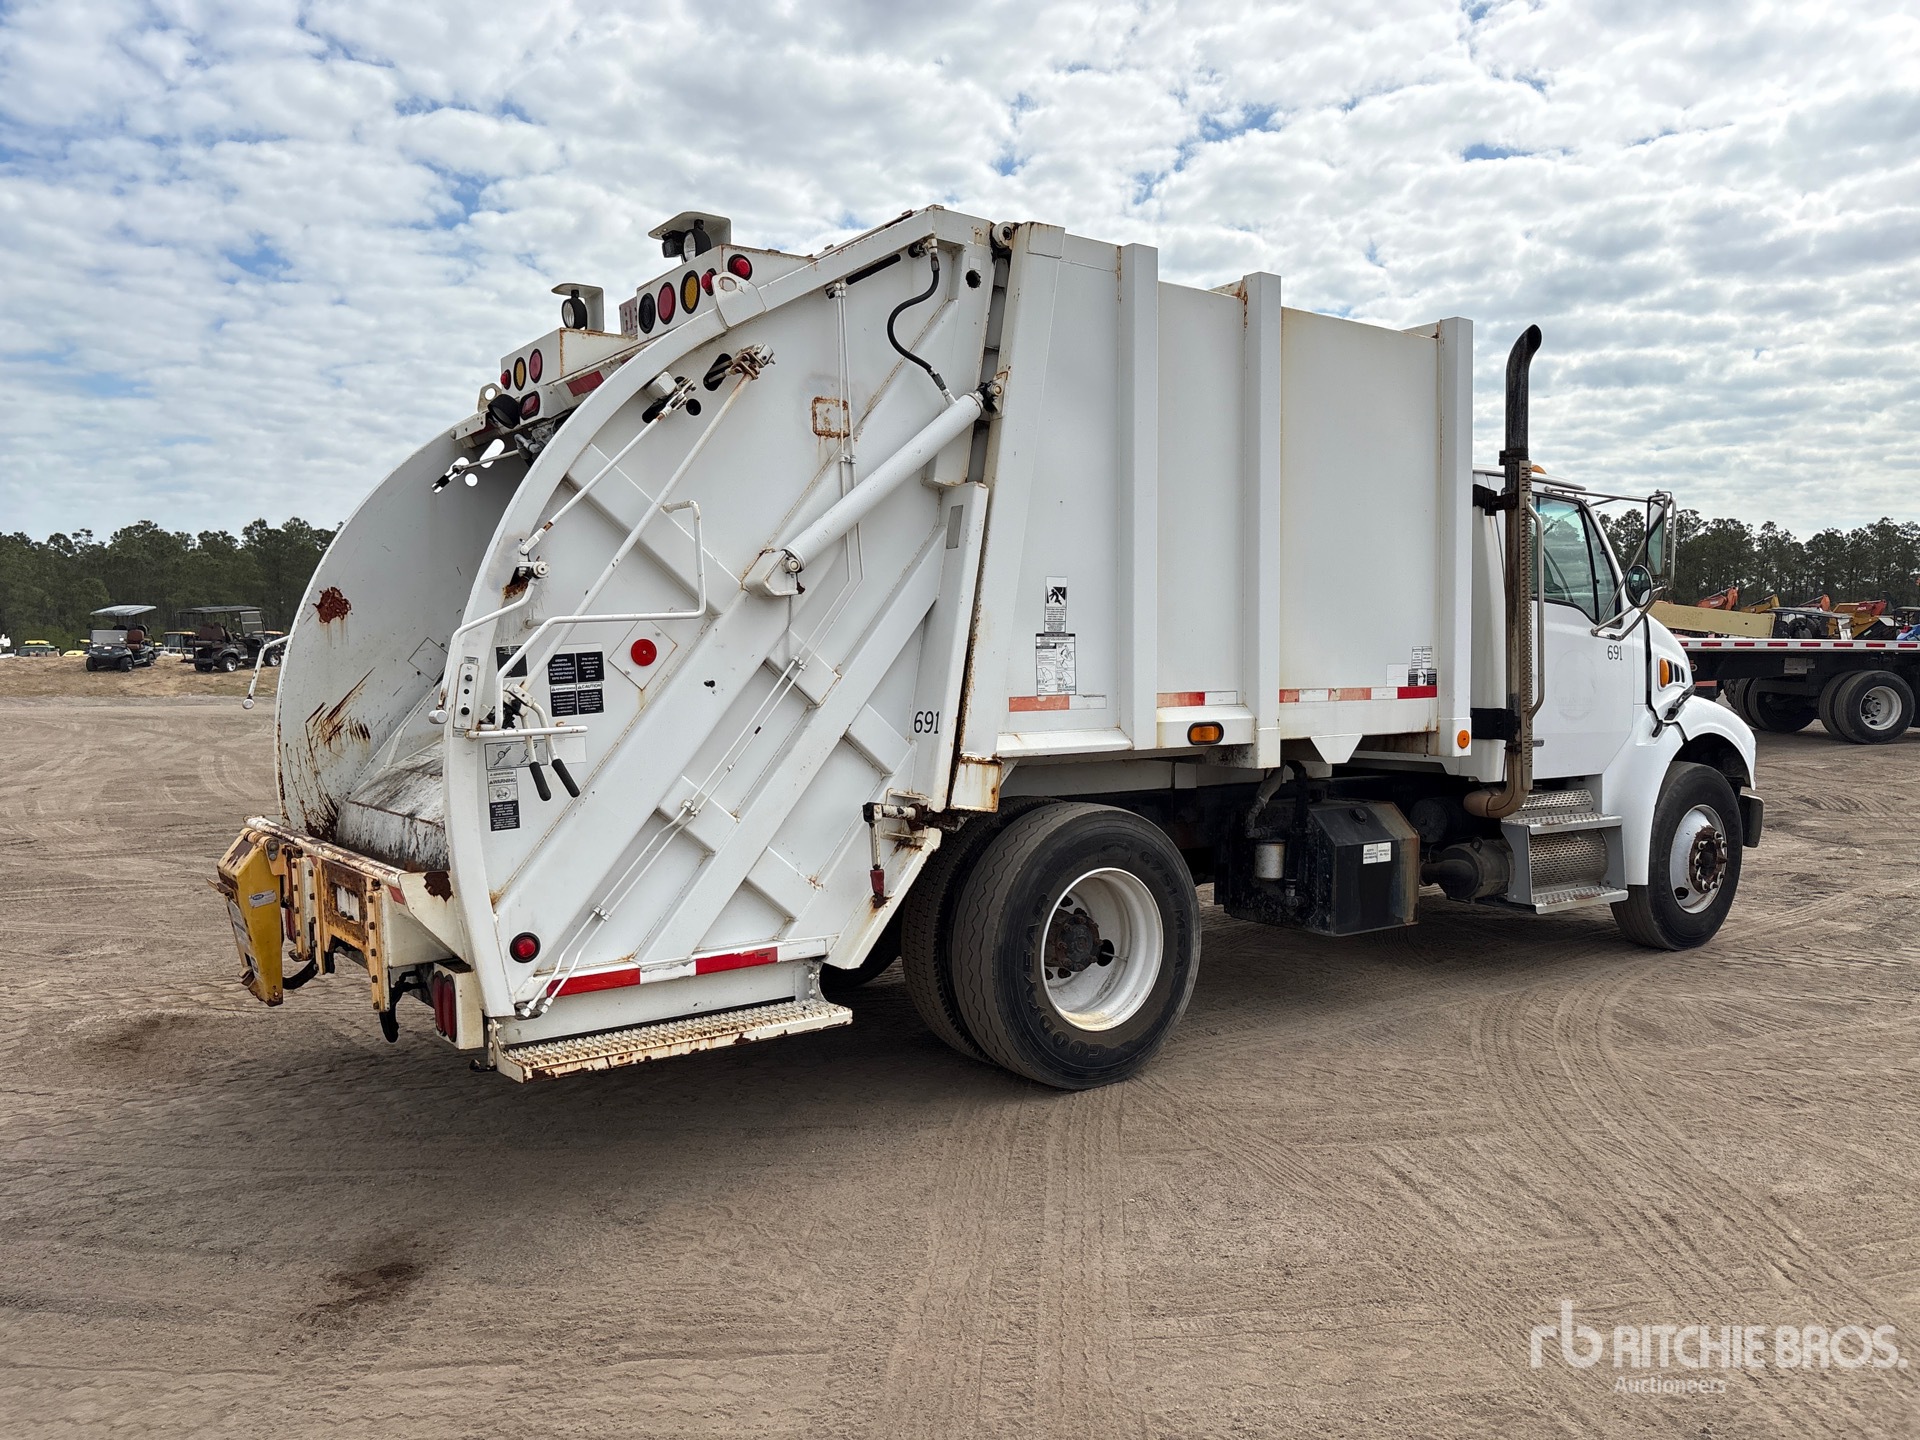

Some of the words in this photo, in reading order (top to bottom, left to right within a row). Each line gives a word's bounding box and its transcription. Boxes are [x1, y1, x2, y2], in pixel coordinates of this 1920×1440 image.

[1607, 644, 1623, 661] 691
[914, 710, 940, 735] 691
[492, 777, 516, 785] WARNING
